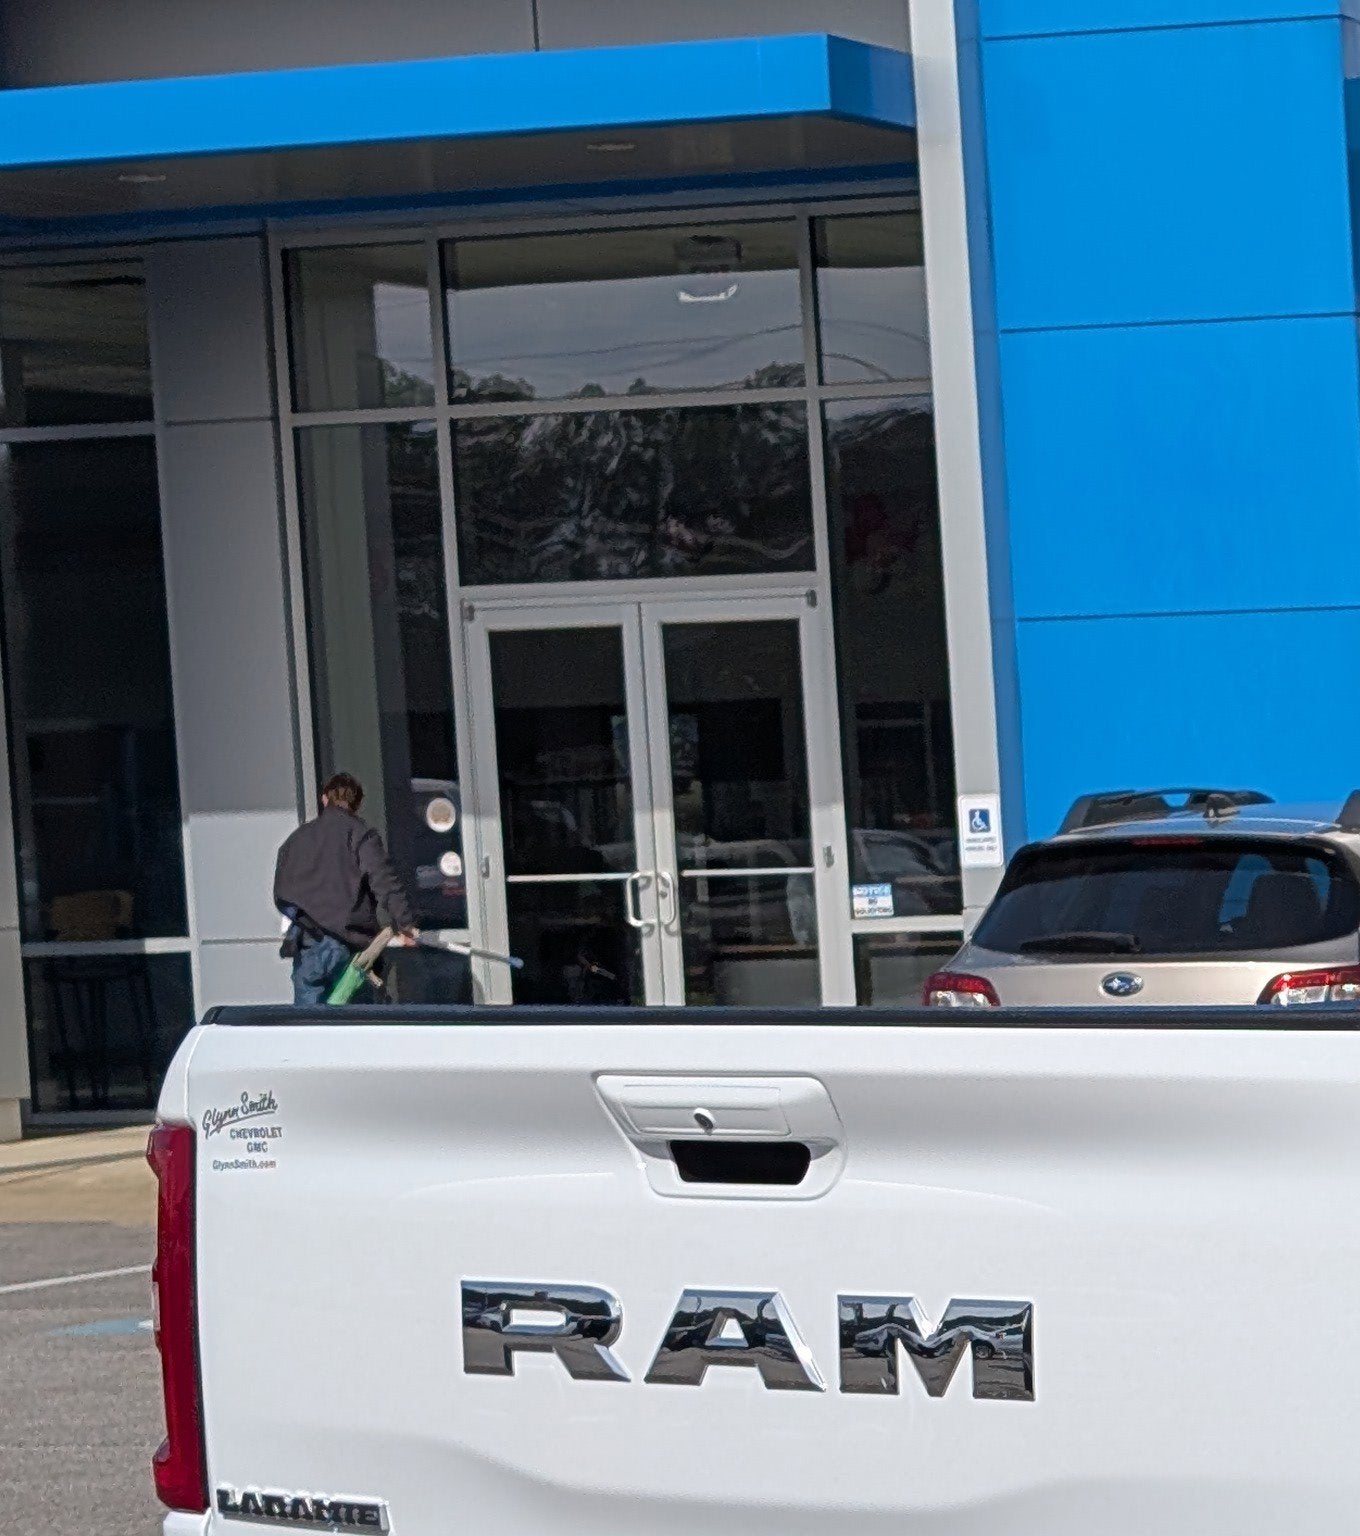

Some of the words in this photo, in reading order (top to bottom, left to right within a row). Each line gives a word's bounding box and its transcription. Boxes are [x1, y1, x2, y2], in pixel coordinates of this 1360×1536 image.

[202, 1107, 240, 1140] Glynn
[240, 1090, 279, 1116] Smith
[230, 1126, 283, 1140] CHEVROLET
[246, 1140, 269, 1154] GMC
[460, 1275, 1036, 1402] RAM
